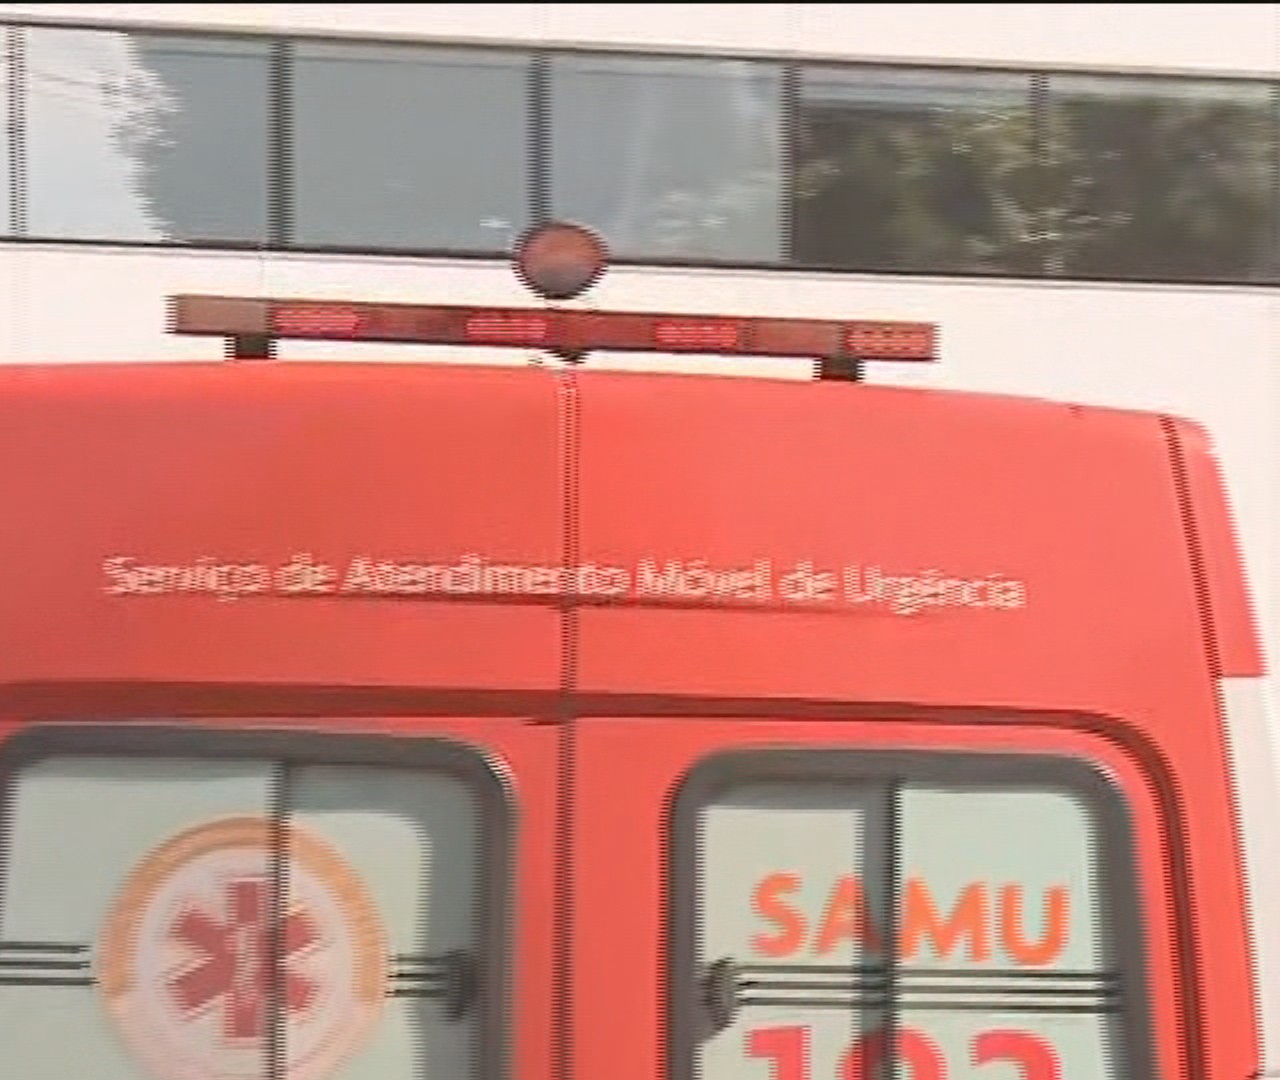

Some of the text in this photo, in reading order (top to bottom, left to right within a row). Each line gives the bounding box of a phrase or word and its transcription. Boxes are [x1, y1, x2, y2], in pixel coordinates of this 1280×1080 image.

[103, 552, 1027, 616] Serviço de Atendimento Móvel de Urgência
[748, 869, 1072, 967] SAMU
